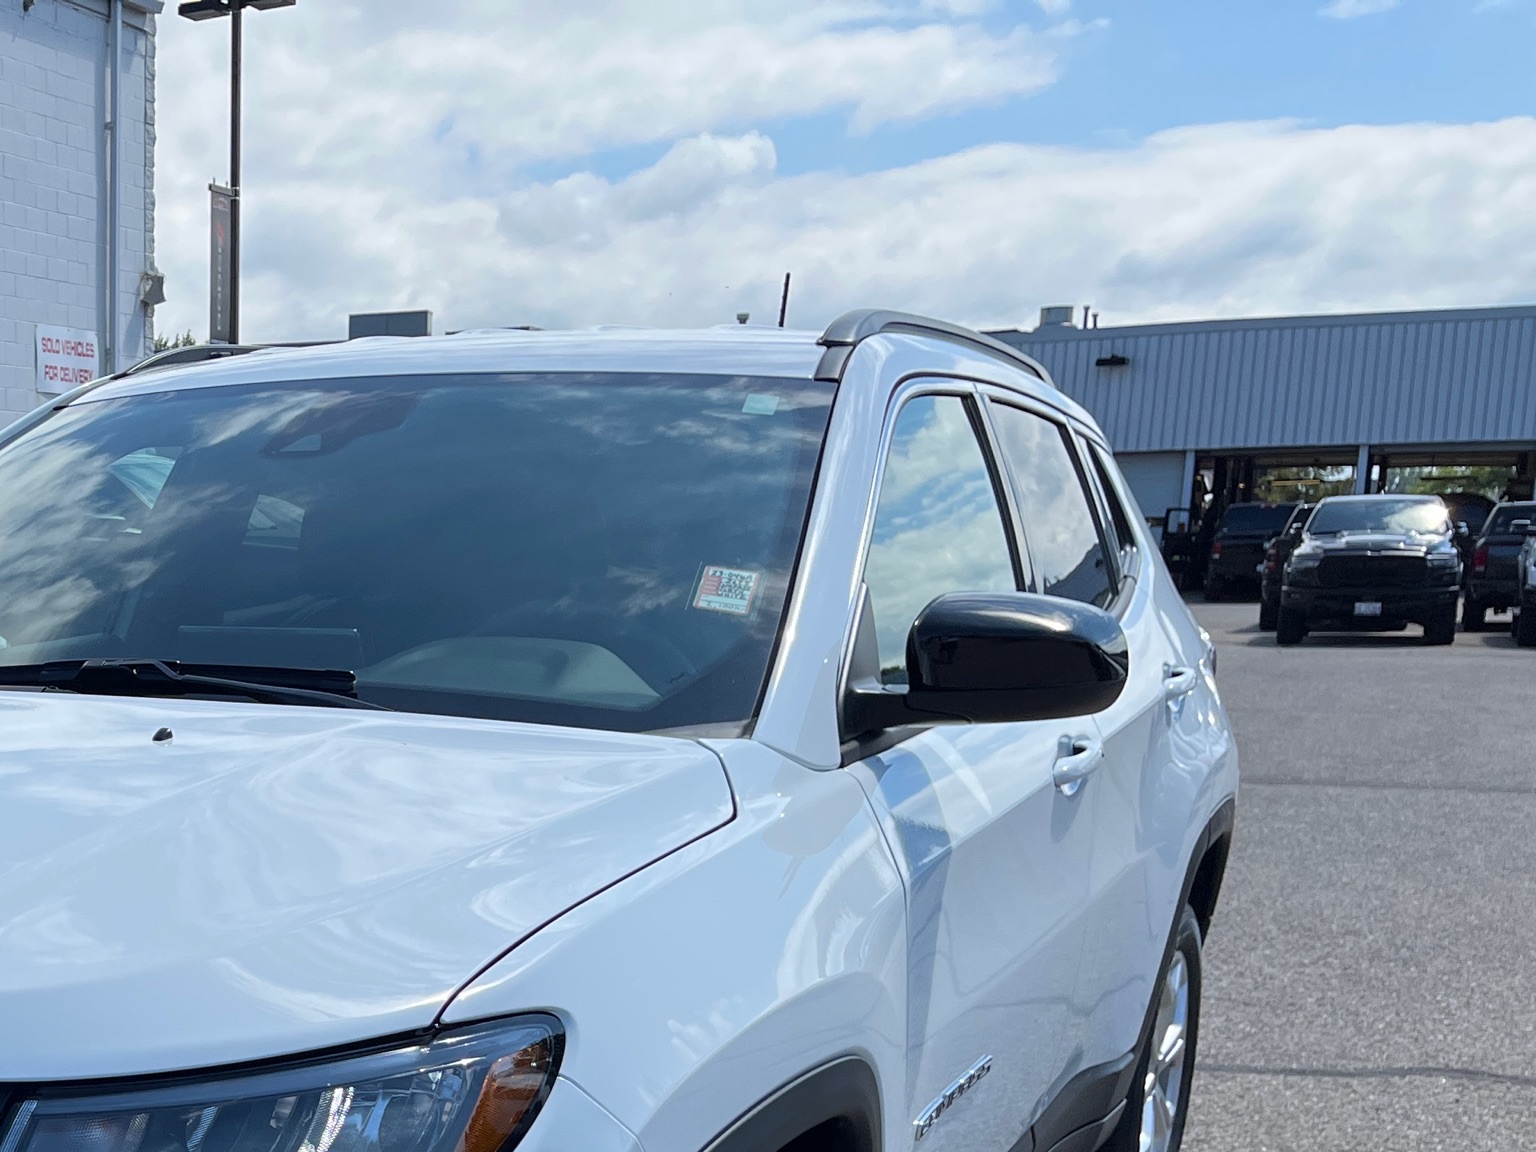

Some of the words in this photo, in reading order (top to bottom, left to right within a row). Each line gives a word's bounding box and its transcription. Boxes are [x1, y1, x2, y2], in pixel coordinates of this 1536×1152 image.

[41, 336, 60, 354] SOLD
[61, 339, 95, 358] VEHICLES
[44, 364, 59, 381] FOR
[60, 366, 93, 384] DELIVERY
